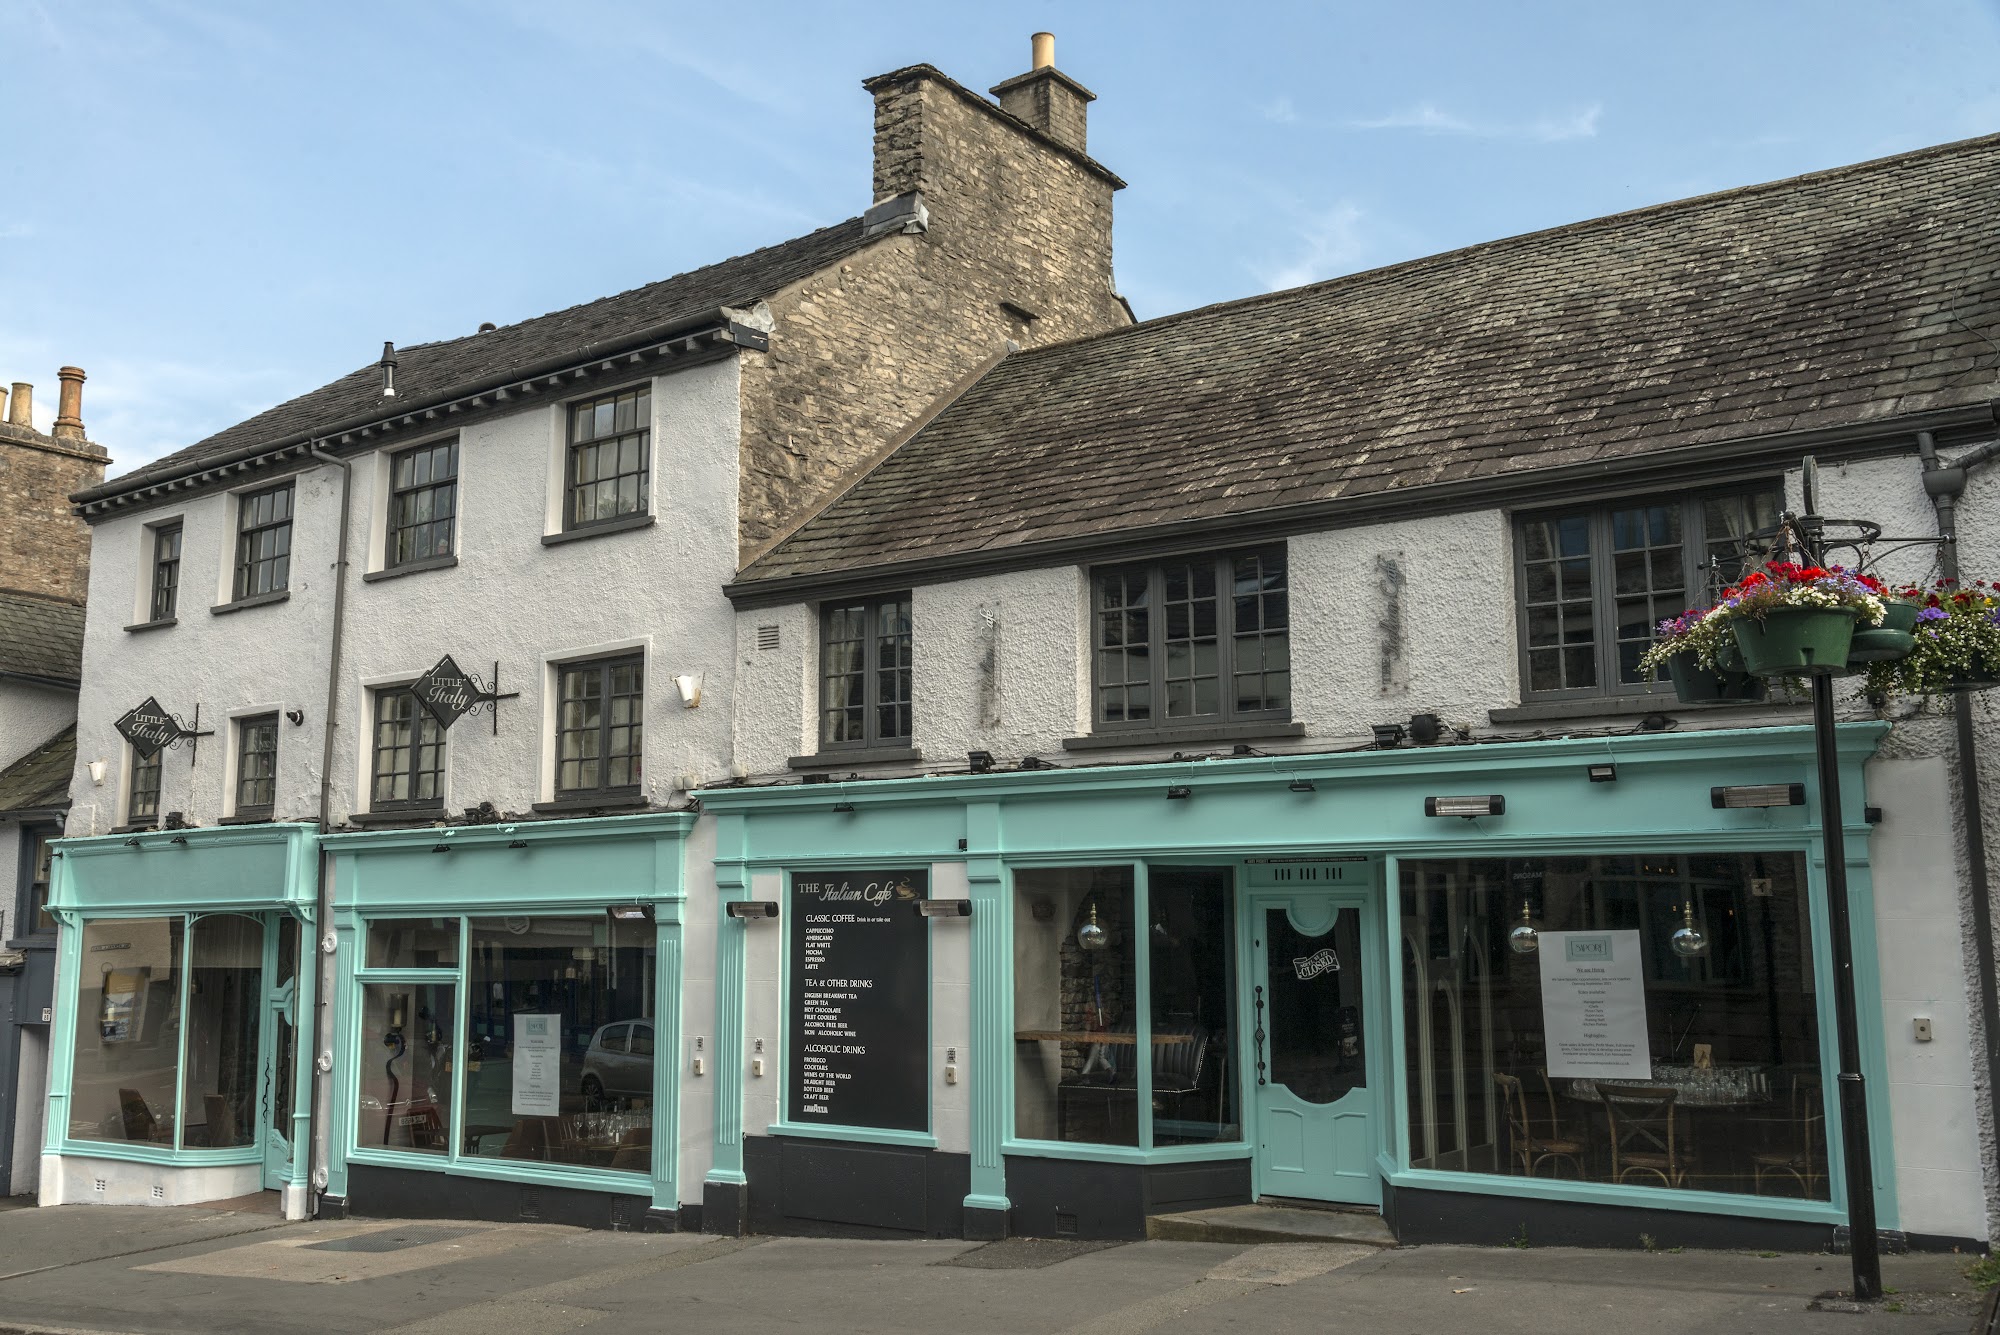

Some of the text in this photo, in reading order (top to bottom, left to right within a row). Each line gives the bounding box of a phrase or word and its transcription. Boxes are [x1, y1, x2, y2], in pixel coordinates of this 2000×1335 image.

[979, 607, 997, 641] Café
[1378, 601, 1400, 661] Italian
[431, 677, 463, 687] LITTLE
[426, 686, 471, 711] Italy
[135, 714, 165, 725] LITTLE
[128, 722, 170, 746] Italy
[798, 880, 894, 907] THE Italian Café
[806, 914, 830, 923] CLASSIC
[832, 914, 856, 923] COFFEE
[1301, 954, 1334, 977] CLOSED
[804, 978, 818, 986] TEA
[826, 979, 848, 988] OTHER
[849, 980, 873, 988] DRINKS
[804, 1044, 866, 1054] ALCOHOLIC DRINKS
